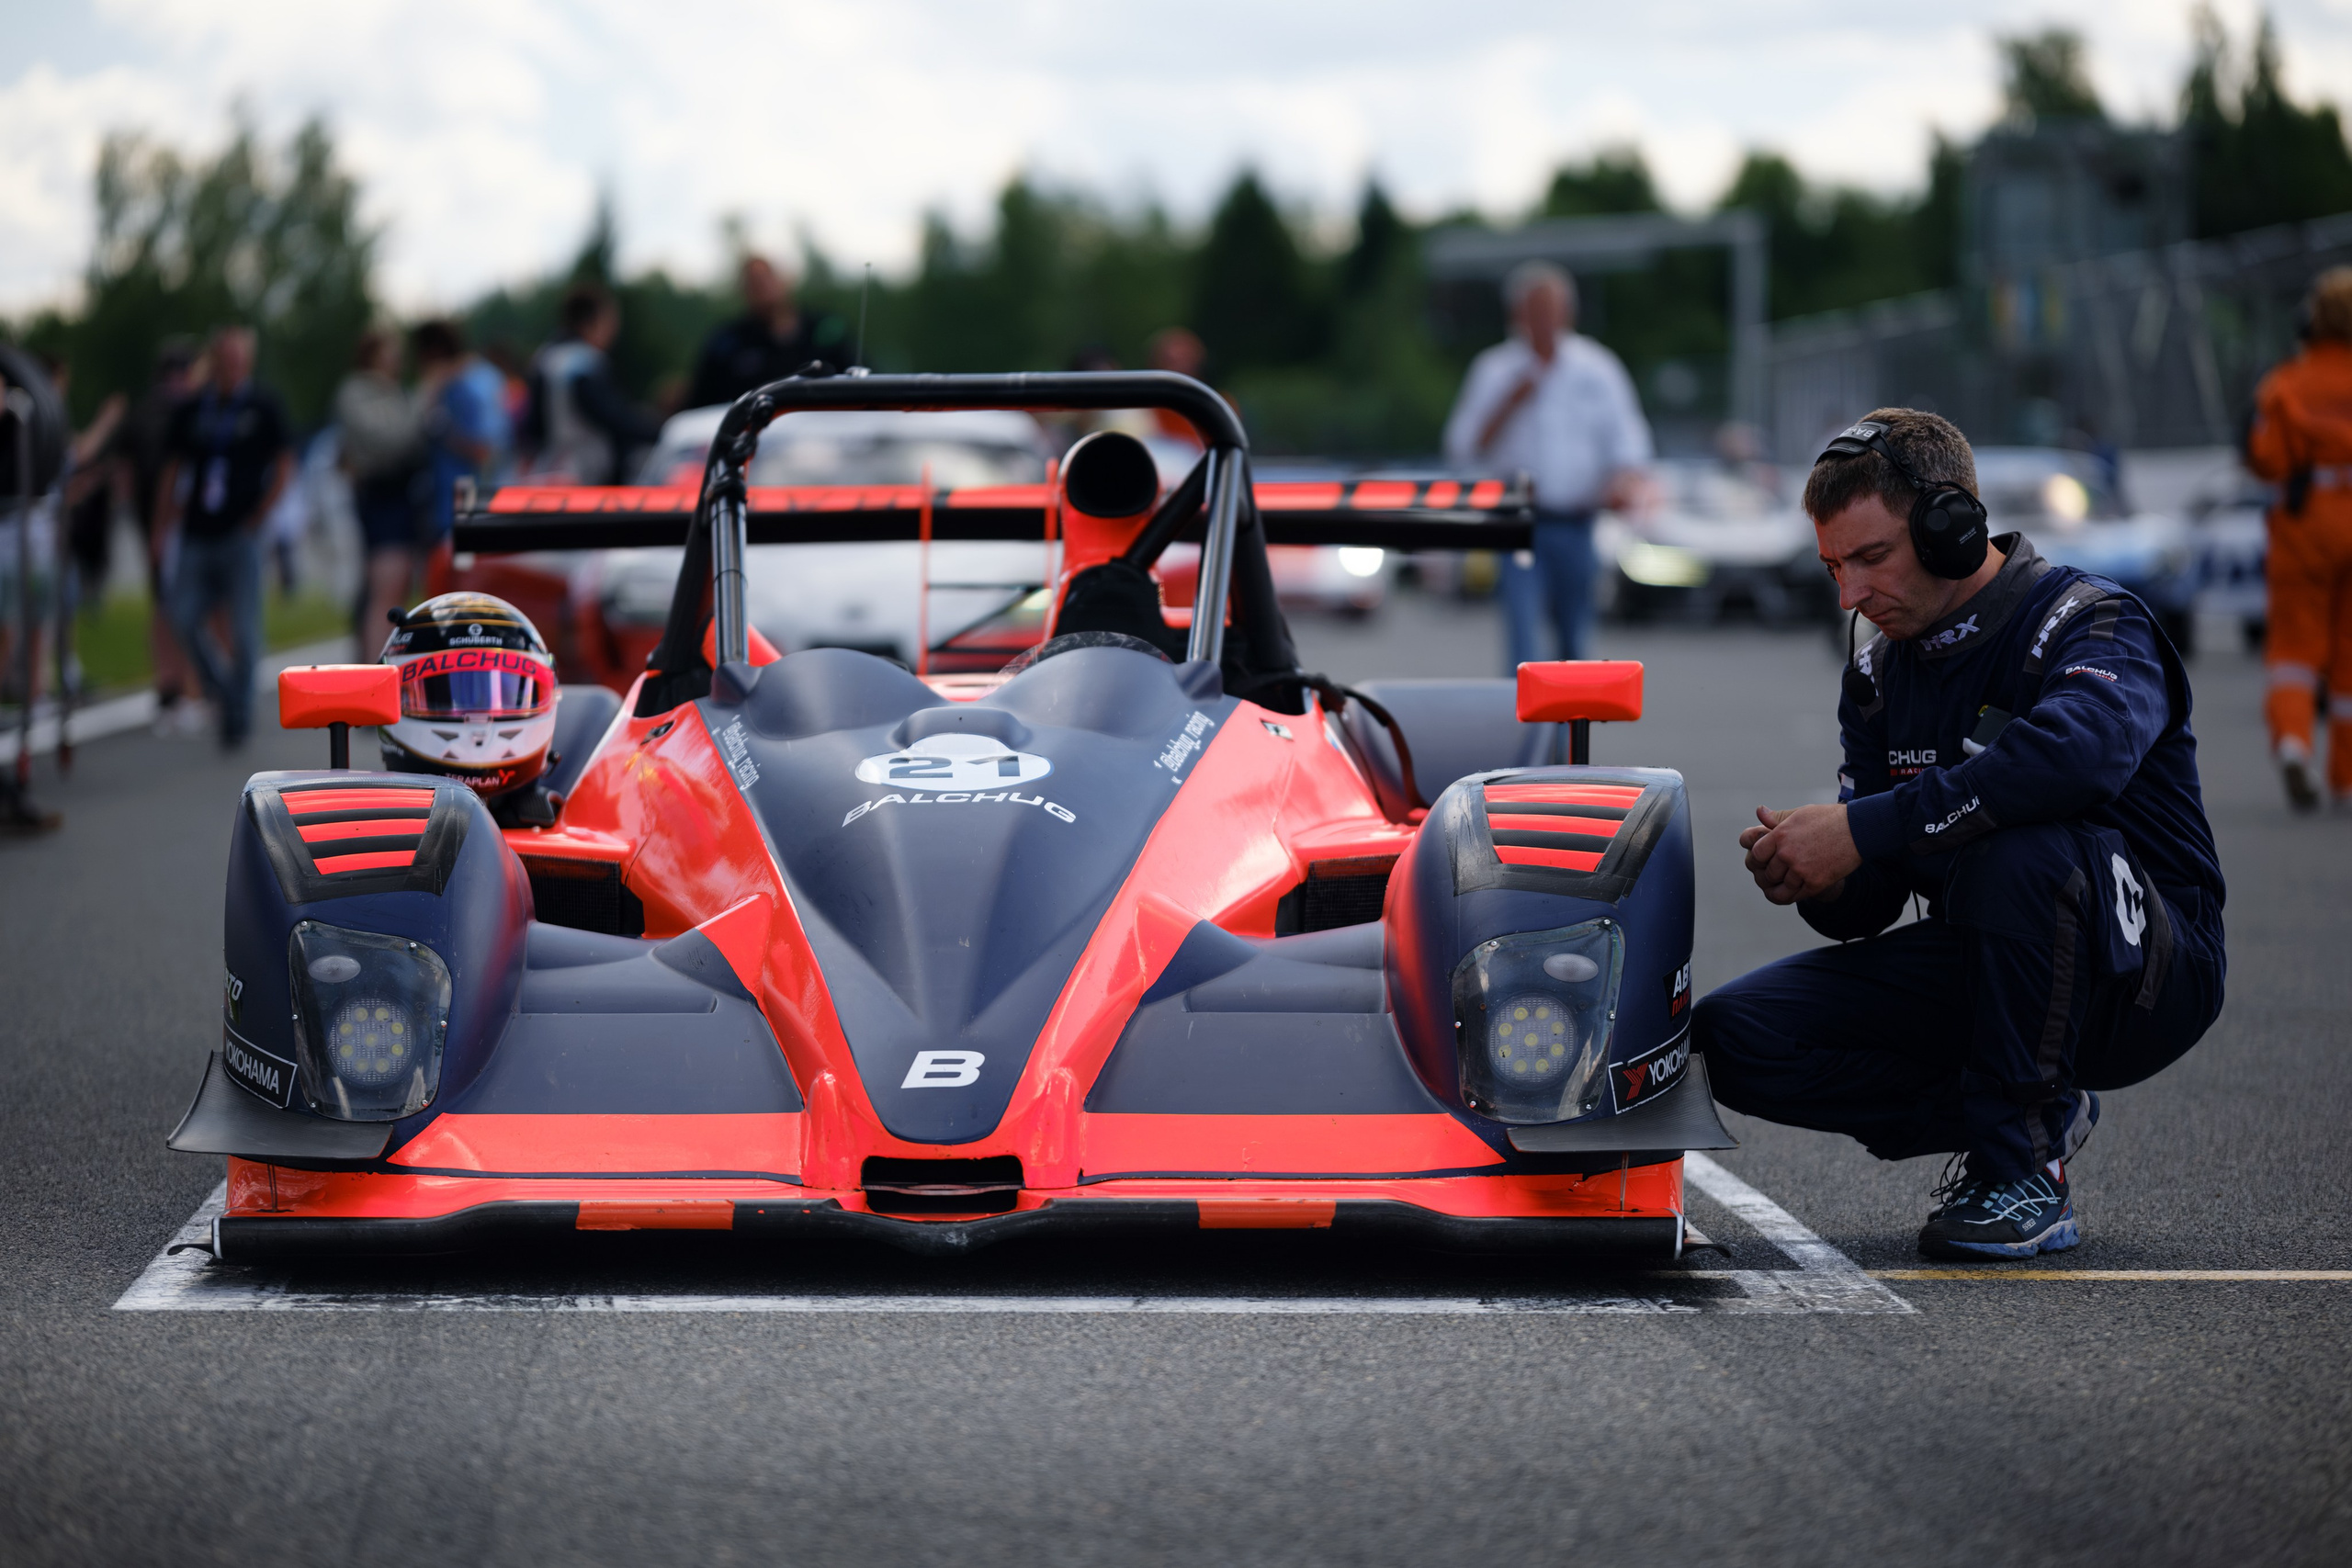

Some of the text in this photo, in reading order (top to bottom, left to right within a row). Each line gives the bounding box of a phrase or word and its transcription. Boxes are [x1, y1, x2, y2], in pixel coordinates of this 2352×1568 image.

[449, 636, 503, 647] SCHUBERTH
[1919, 613, 1980, 651] HRX
[401, 651, 537, 682] BALCHUG
[2065, 665, 2118, 680] BALCHUG
[888, 755, 1021, 779] 21
[842, 792, 1077, 828] BALCHUG
[900, 1049, 986, 1089] B
